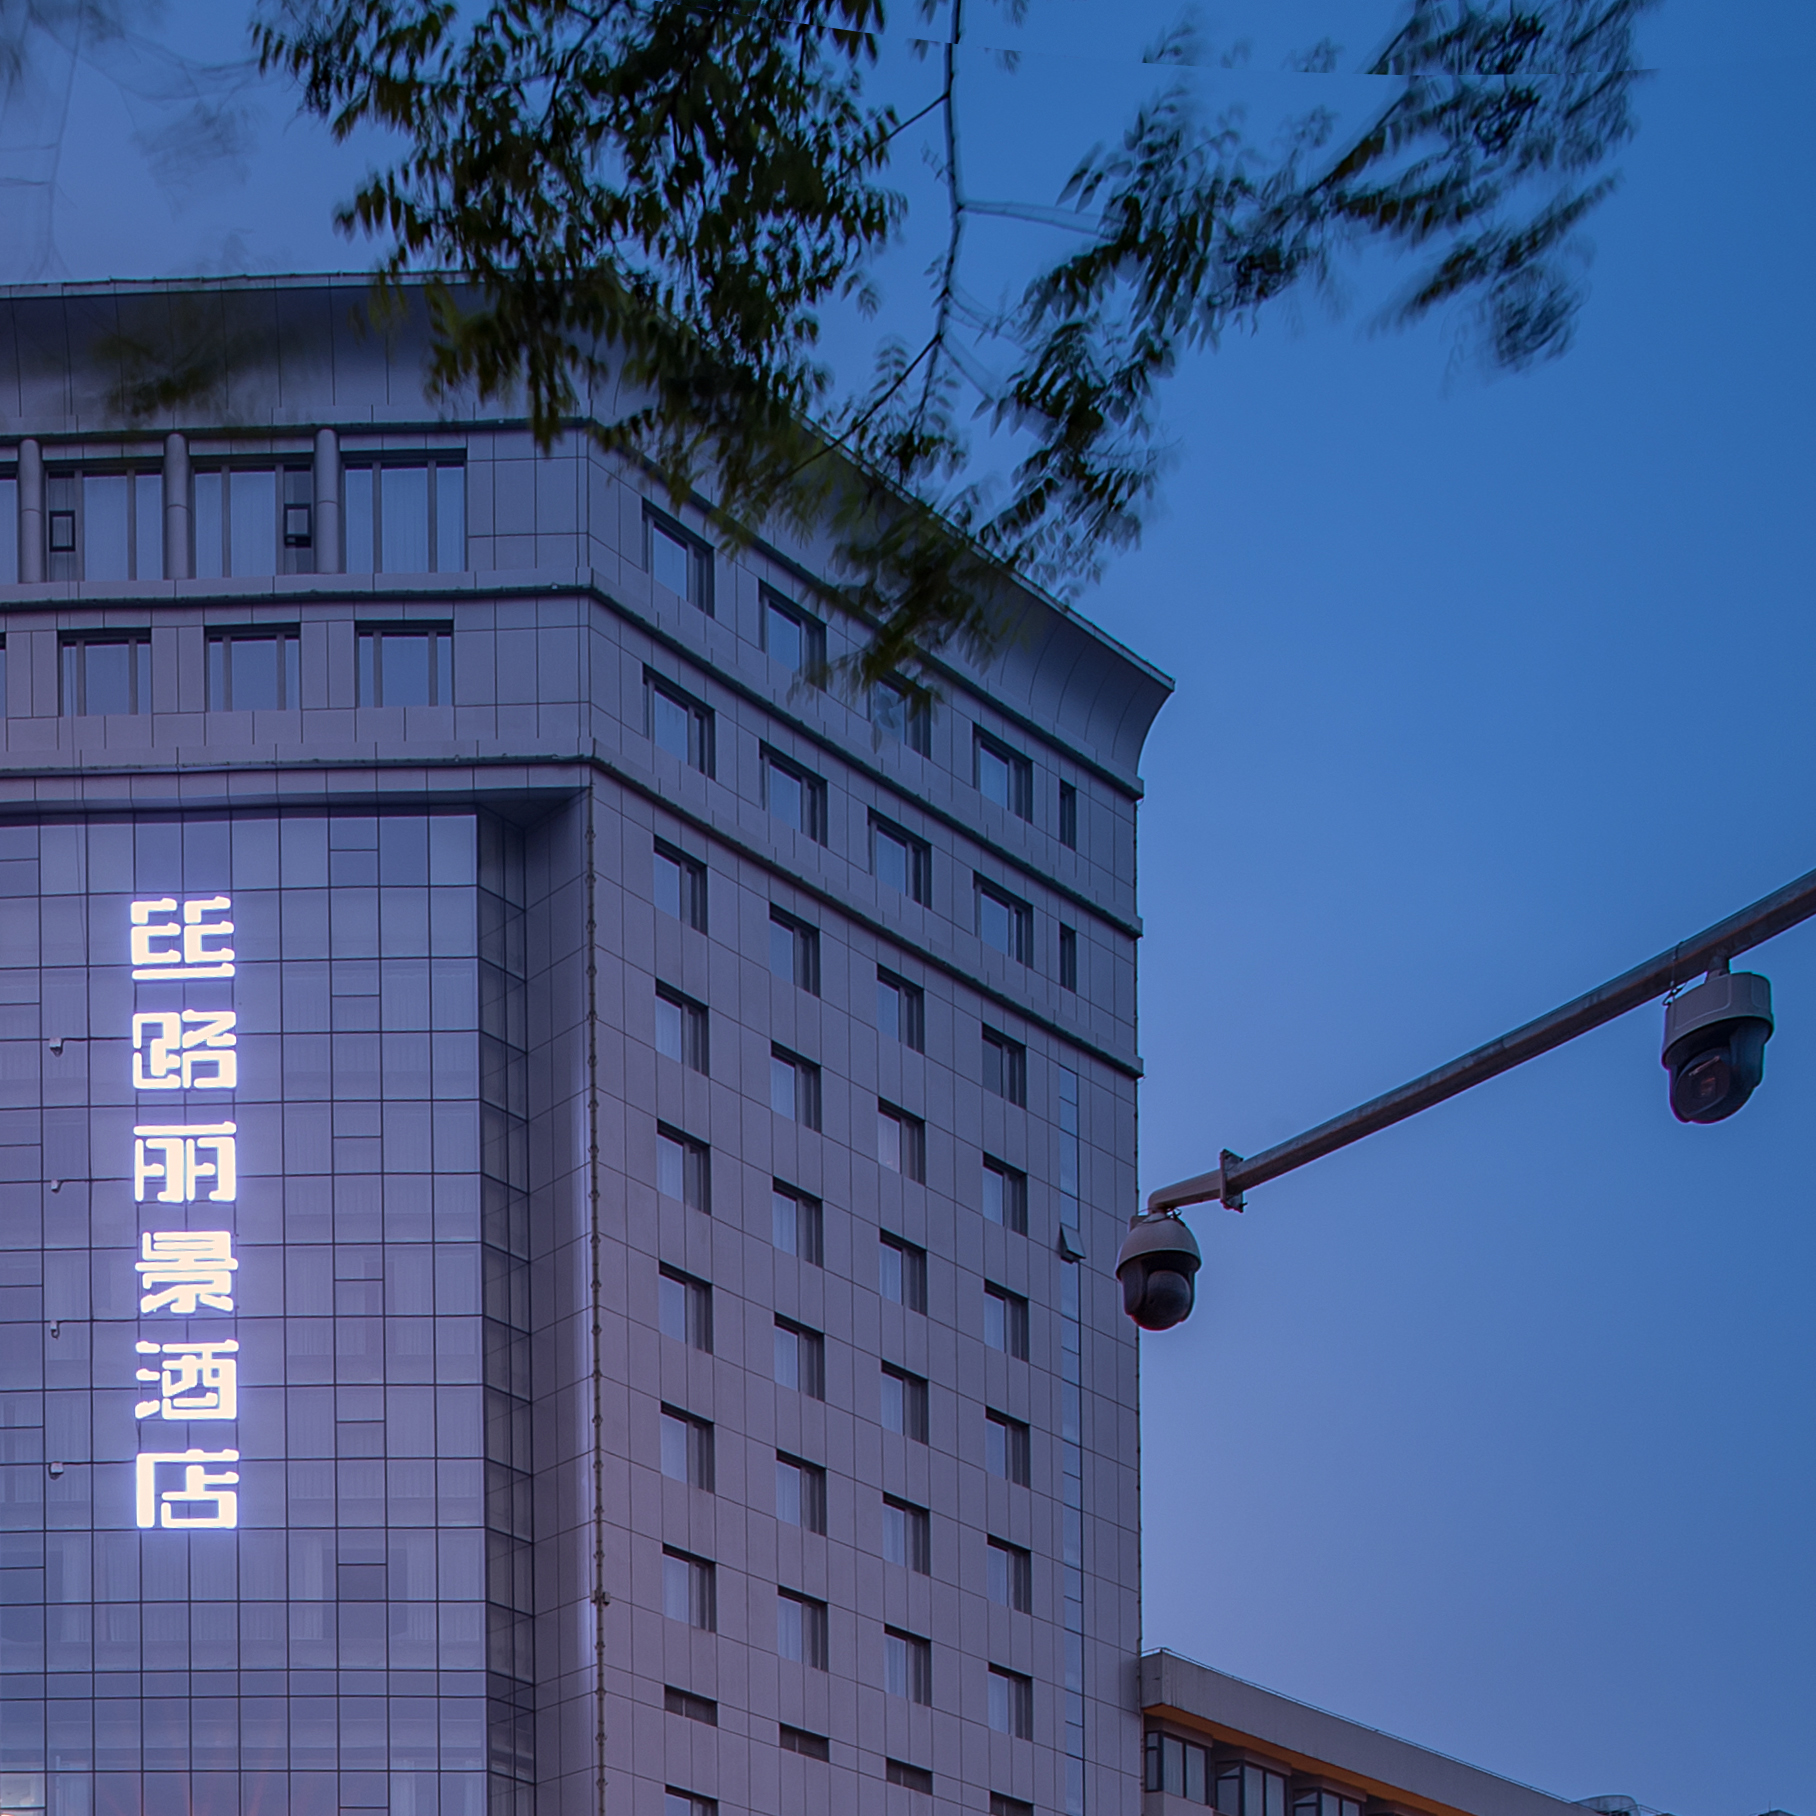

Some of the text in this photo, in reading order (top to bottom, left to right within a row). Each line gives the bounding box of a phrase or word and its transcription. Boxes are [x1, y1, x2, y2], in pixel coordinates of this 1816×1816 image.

[130, 896, 239, 1529] 丝路丽景酒店
